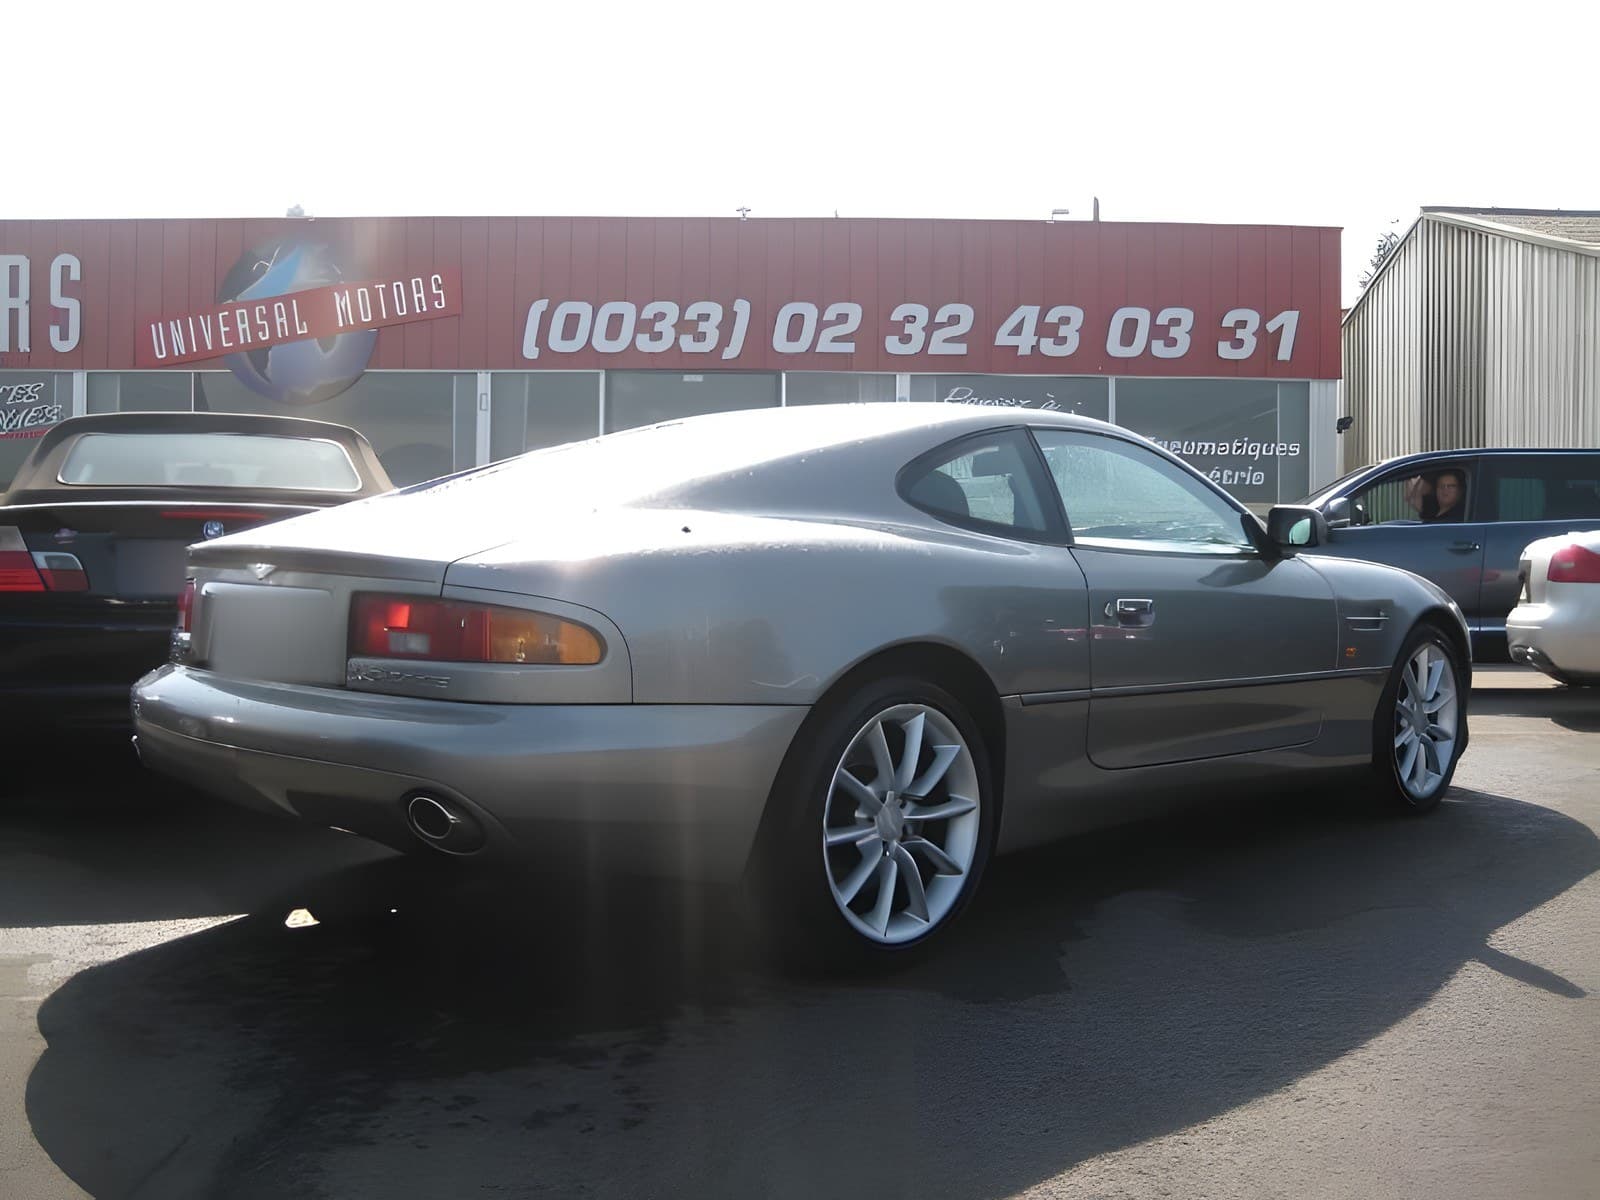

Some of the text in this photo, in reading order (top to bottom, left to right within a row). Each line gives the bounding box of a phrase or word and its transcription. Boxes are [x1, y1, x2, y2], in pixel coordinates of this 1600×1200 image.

[151, 274, 446, 359] UNIVERSAL MOTORS
[522, 299, 1299, 361] (0033) 02 32 43 03 31
[1147, 437, 1301, 461] neumatiques
